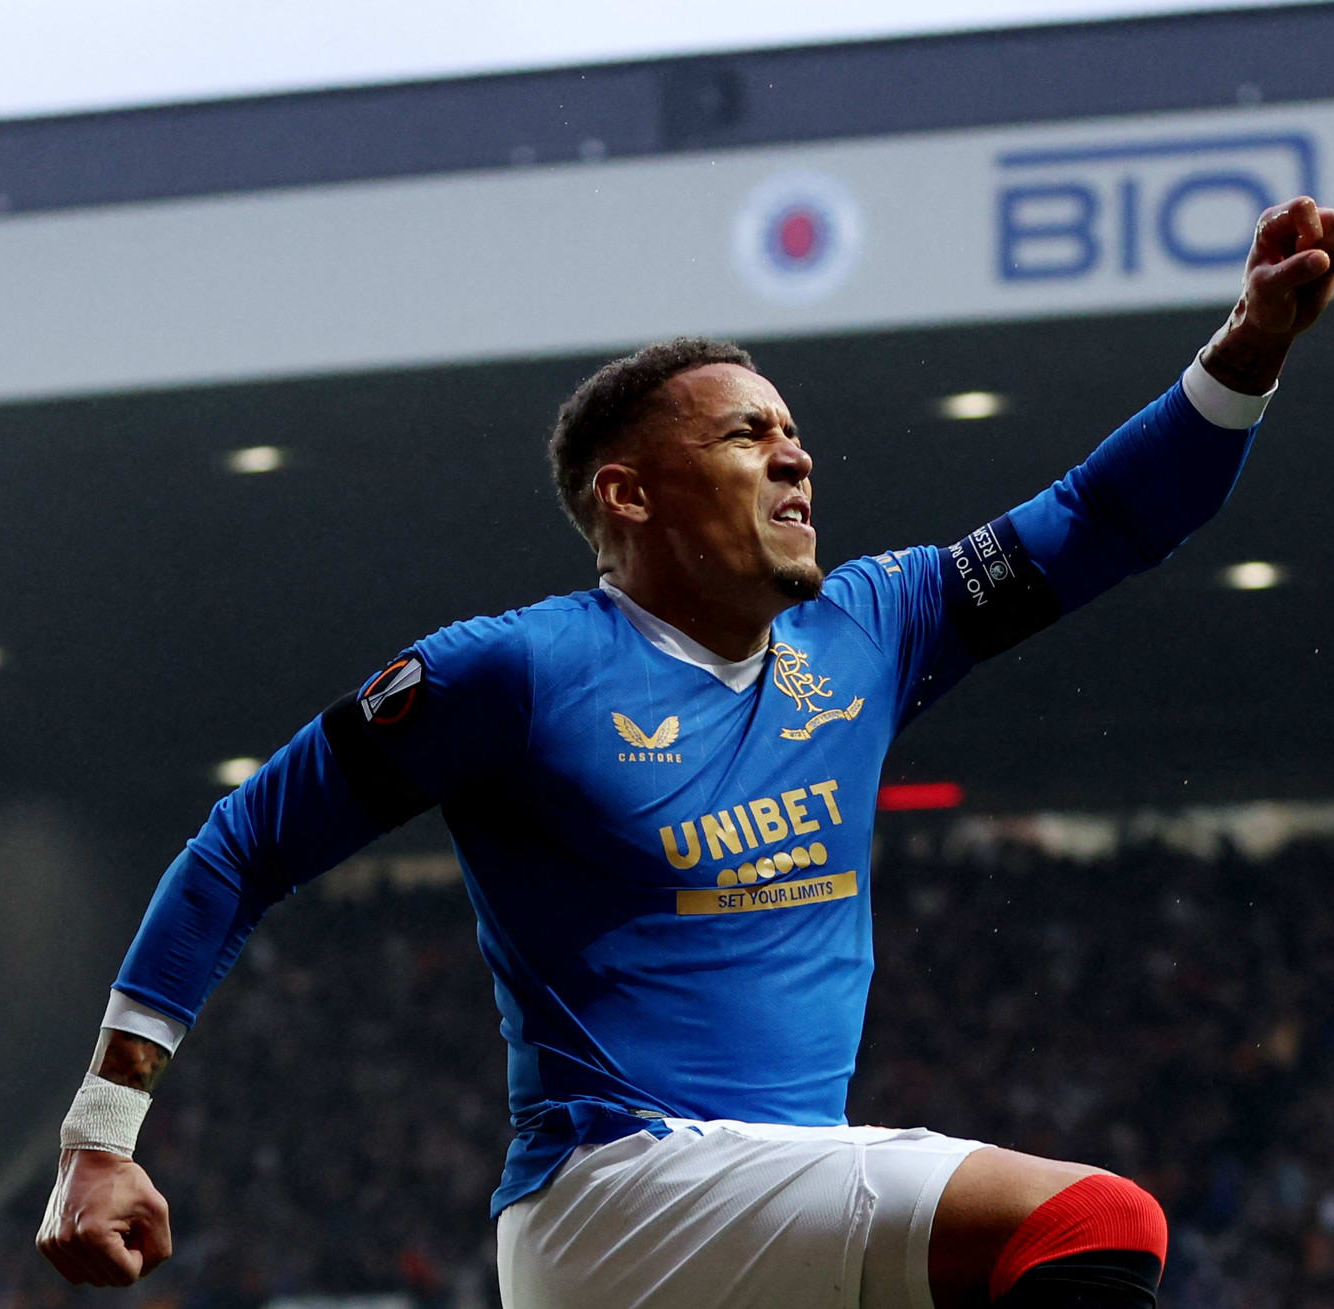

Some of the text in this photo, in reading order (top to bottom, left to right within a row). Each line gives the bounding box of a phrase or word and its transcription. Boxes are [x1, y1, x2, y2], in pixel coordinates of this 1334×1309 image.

[955, 556, 973, 579] TO
[967, 578, 988, 607] NO
[618, 752, 683, 764] CASTORE
[658, 779, 843, 870] UNIBET
[718, 880, 834, 909] SET YOUR LIMITS
